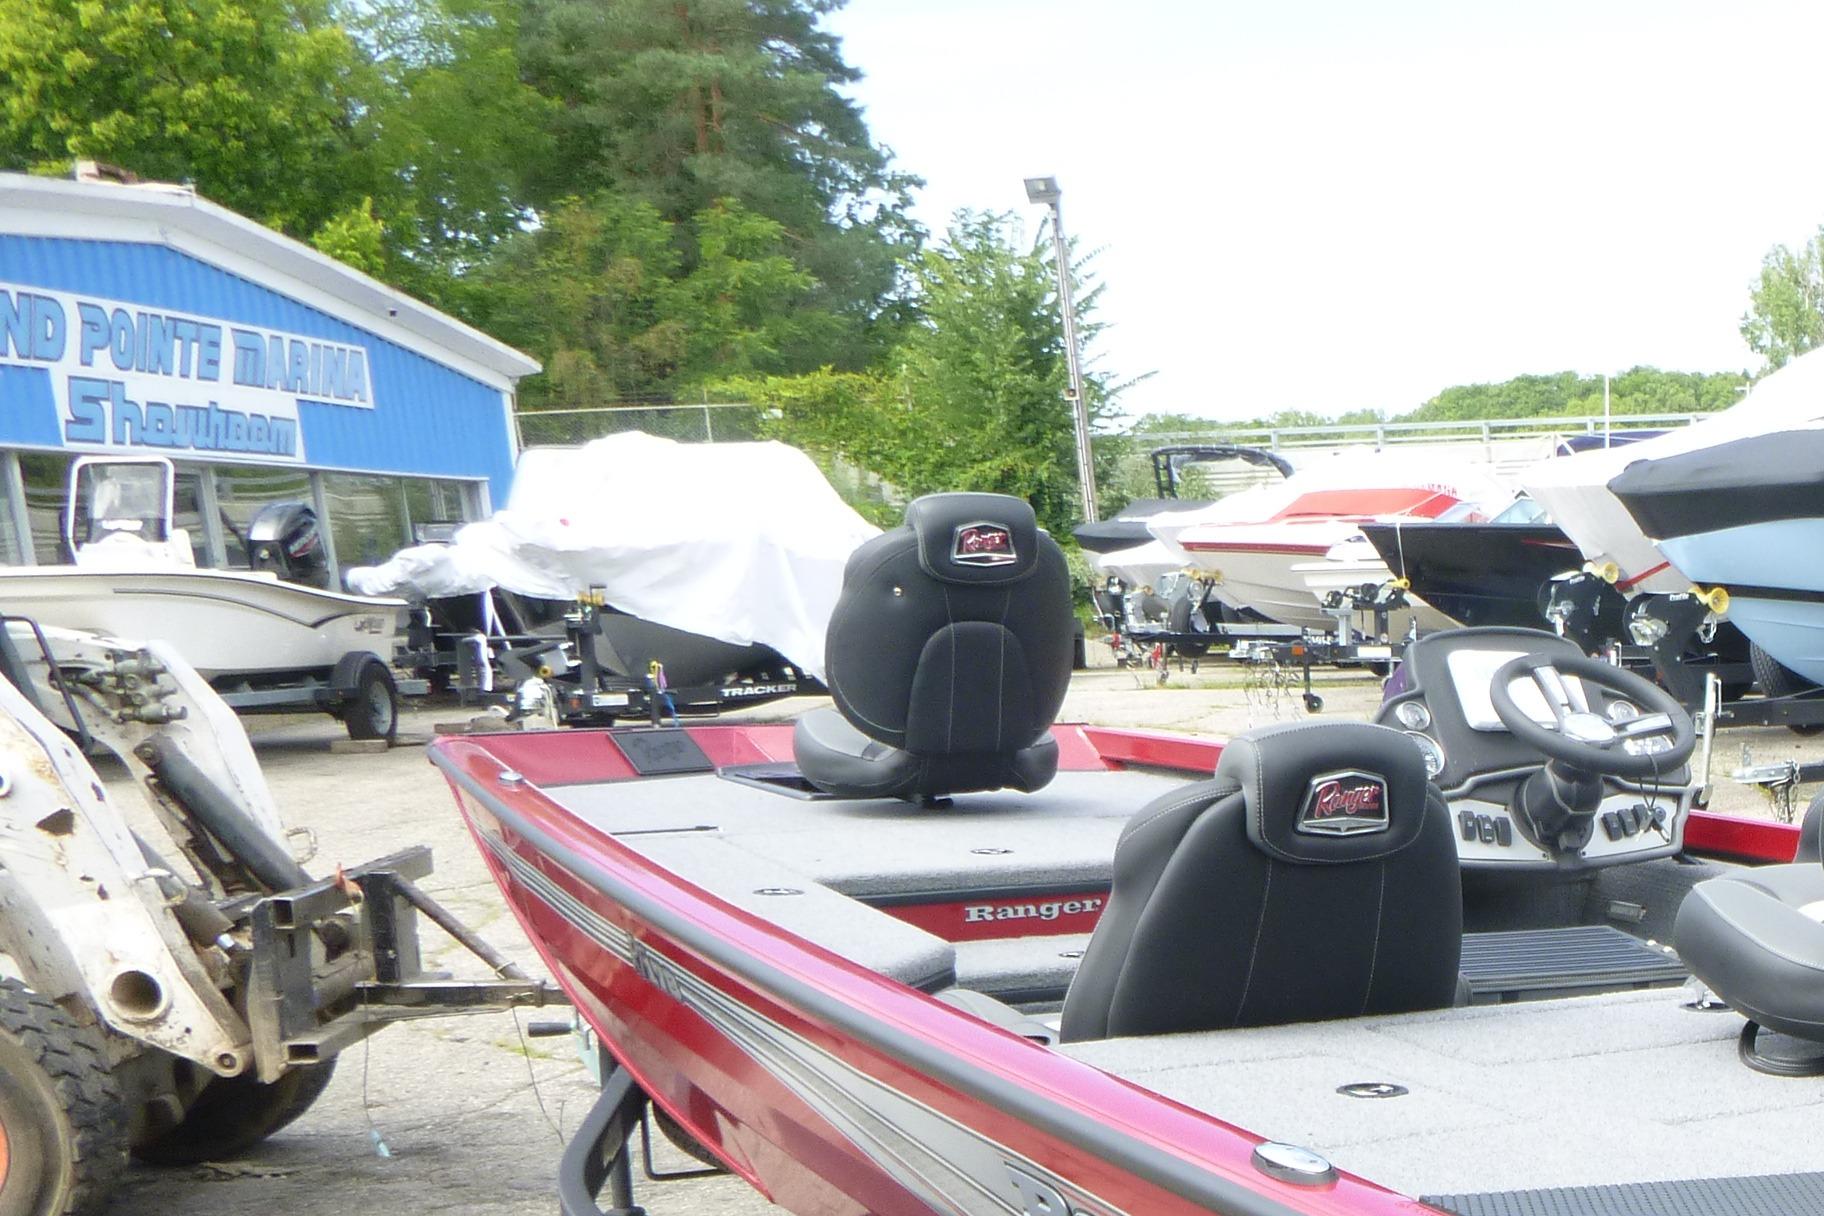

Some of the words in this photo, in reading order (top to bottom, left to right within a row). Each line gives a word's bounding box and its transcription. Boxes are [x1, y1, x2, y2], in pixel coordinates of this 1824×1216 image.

[77, 301, 222, 382] POINTE
[231, 328, 367, 402] MARINA
[65, 375, 297, 457] Showroom
[721, 683, 797, 697] TRACKER
[1314, 780, 1381, 818] Ranger
[964, 898, 1102, 922] Ranger
